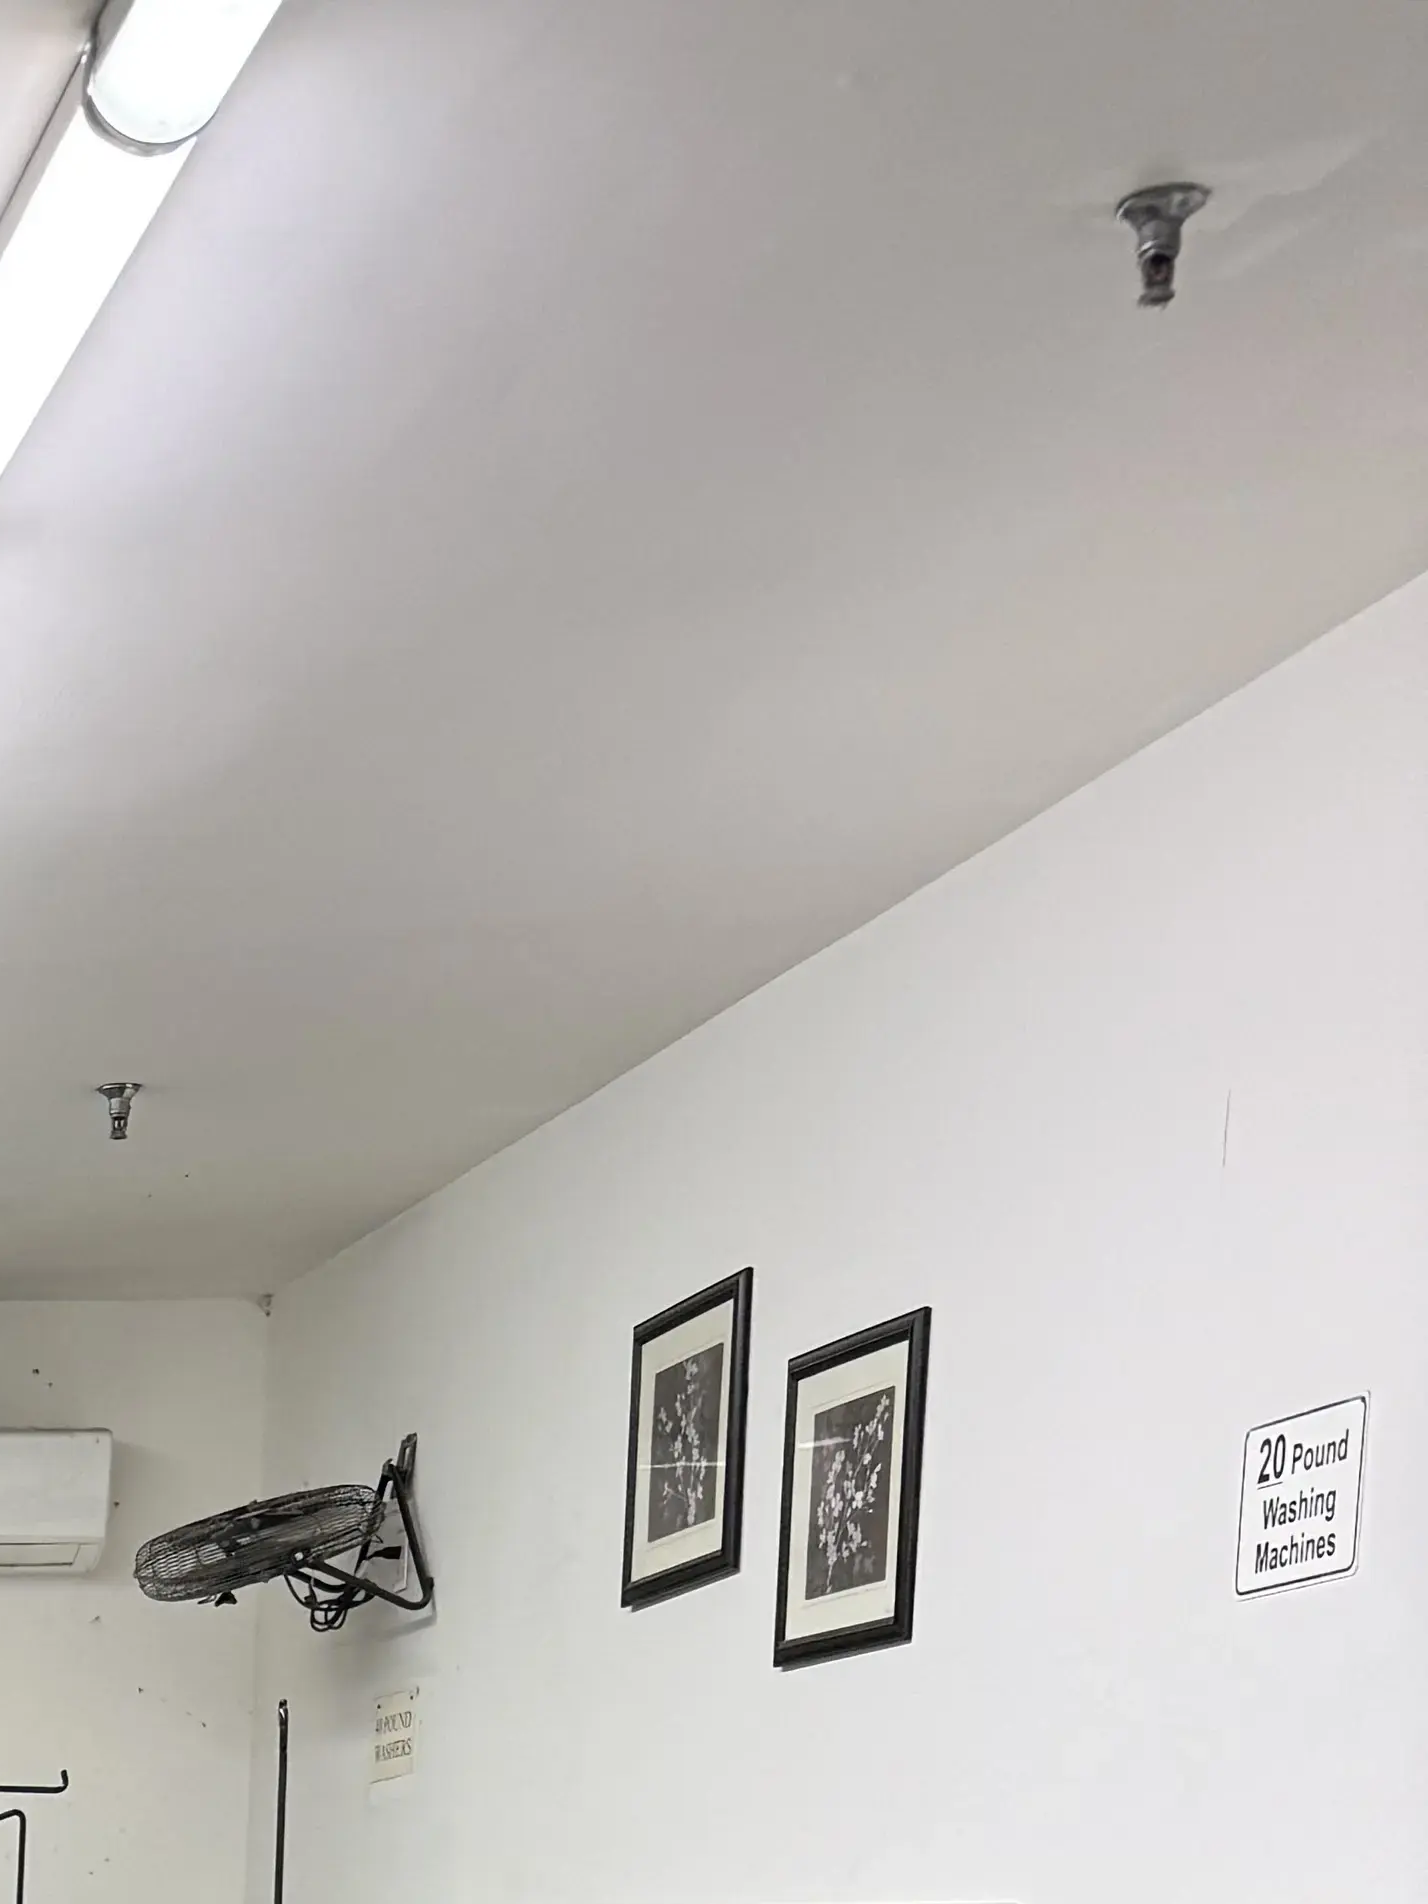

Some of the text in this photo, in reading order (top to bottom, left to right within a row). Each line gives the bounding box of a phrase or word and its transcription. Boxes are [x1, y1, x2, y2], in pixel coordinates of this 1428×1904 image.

[1256, 1428, 1349, 1485] 20 Pound
[1262, 1487, 1337, 1530] Washing
[1254, 1532, 1336, 1574] Machines
